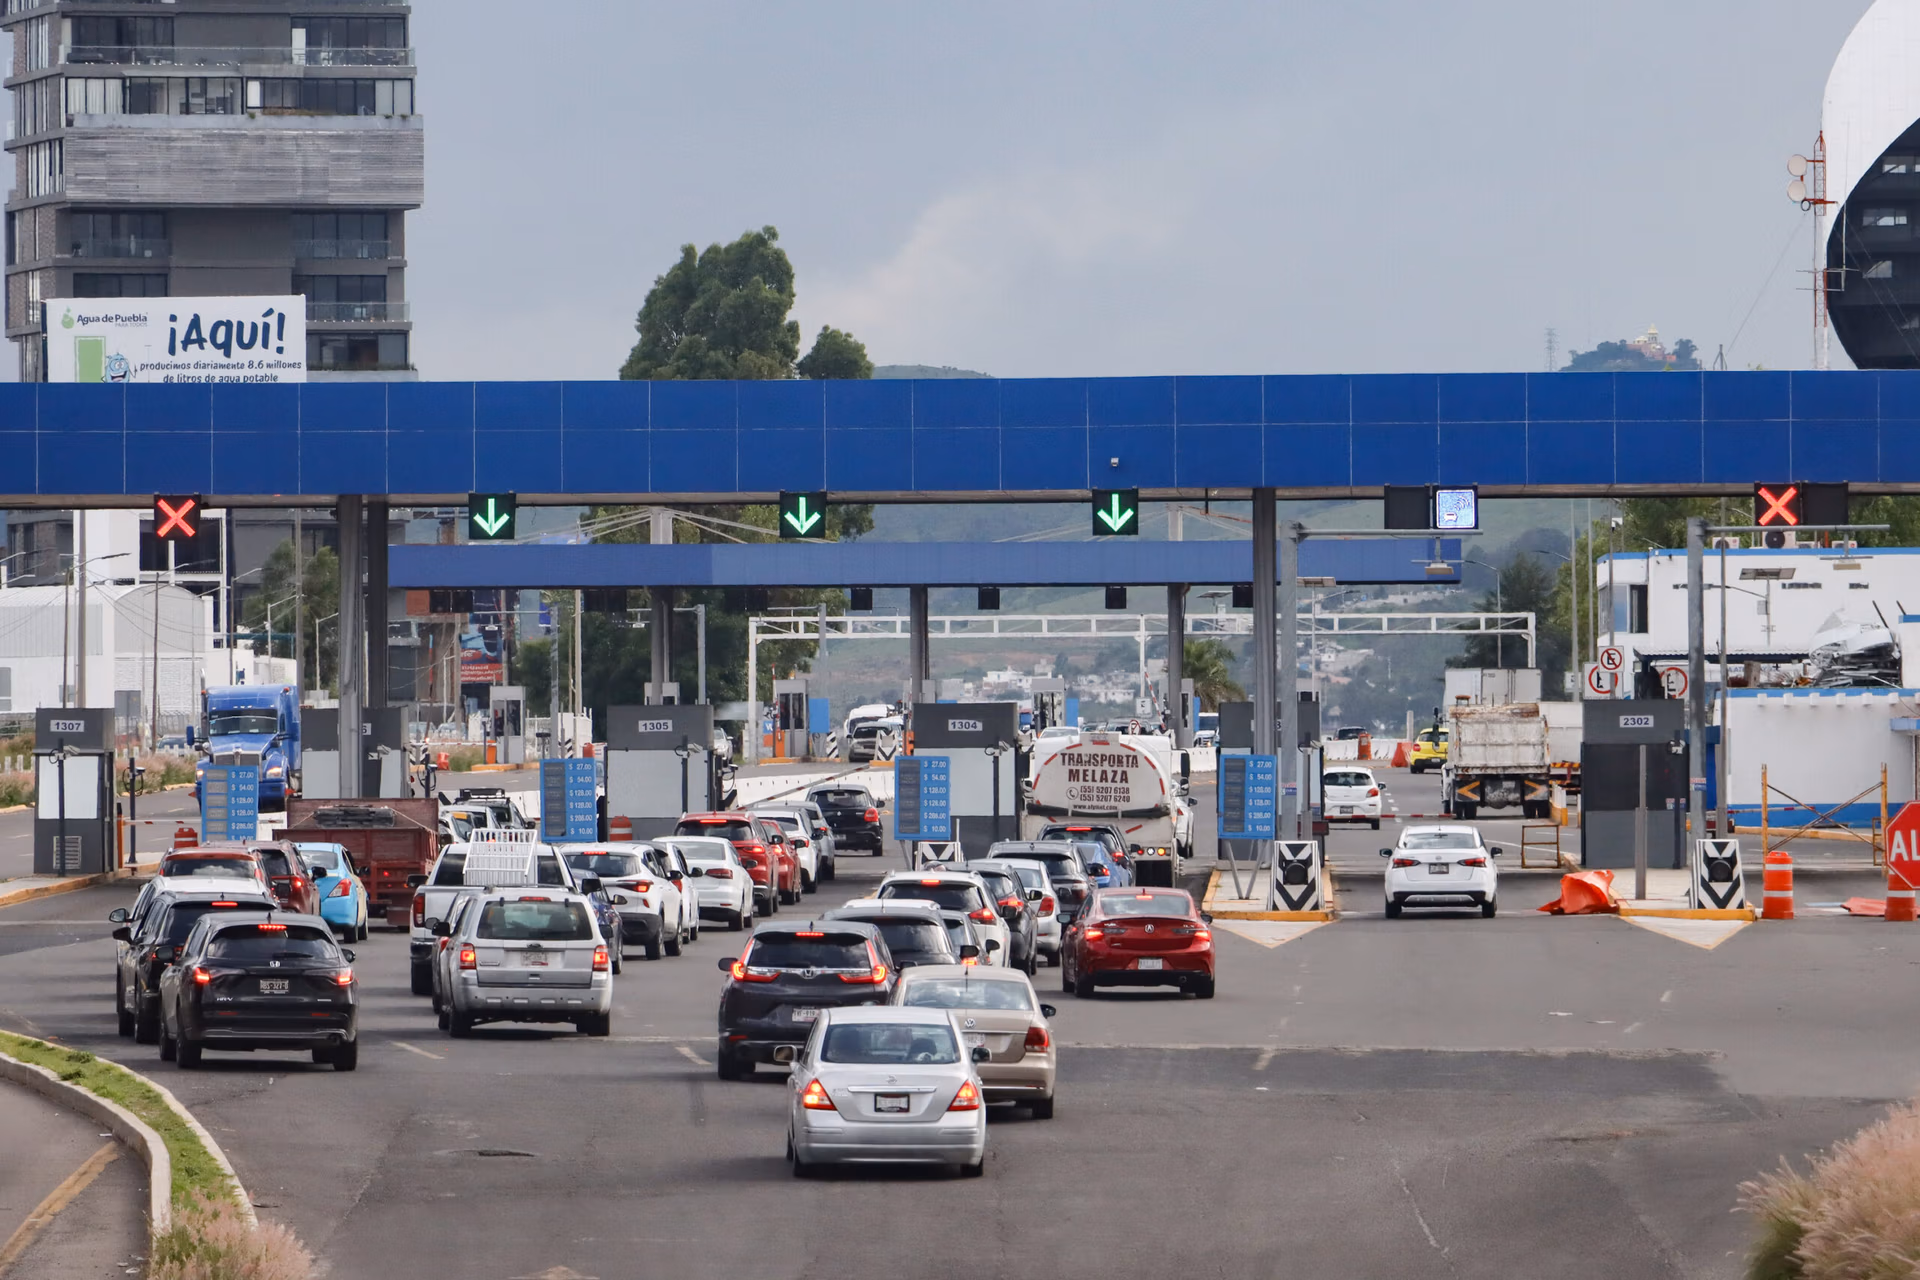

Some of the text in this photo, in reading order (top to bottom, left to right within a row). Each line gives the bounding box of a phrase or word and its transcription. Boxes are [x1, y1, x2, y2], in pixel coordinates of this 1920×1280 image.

[76, 314, 148, 326] Agua de Puebla
[168, 308, 285, 358] ¡Aquí!
[140, 360, 302, 371] producimos diariamente 8.6 millones
[163, 374, 175, 382] de
[177, 374, 202, 382] litros
[204, 374, 216, 382] de
[244, 374, 278, 383] potable
[55, 721, 81, 731] 1307
[642, 722, 669, 731] 1305
[951, 721, 978, 730] 1304
[1623, 717, 1650, 726] 2302
[1060, 752, 1139, 768] TRANSPORTA
[1068, 769, 1129, 784] MELAZA
[1096, 786, 1112, 794] 5207
[1114, 786, 1130, 795] 6138
